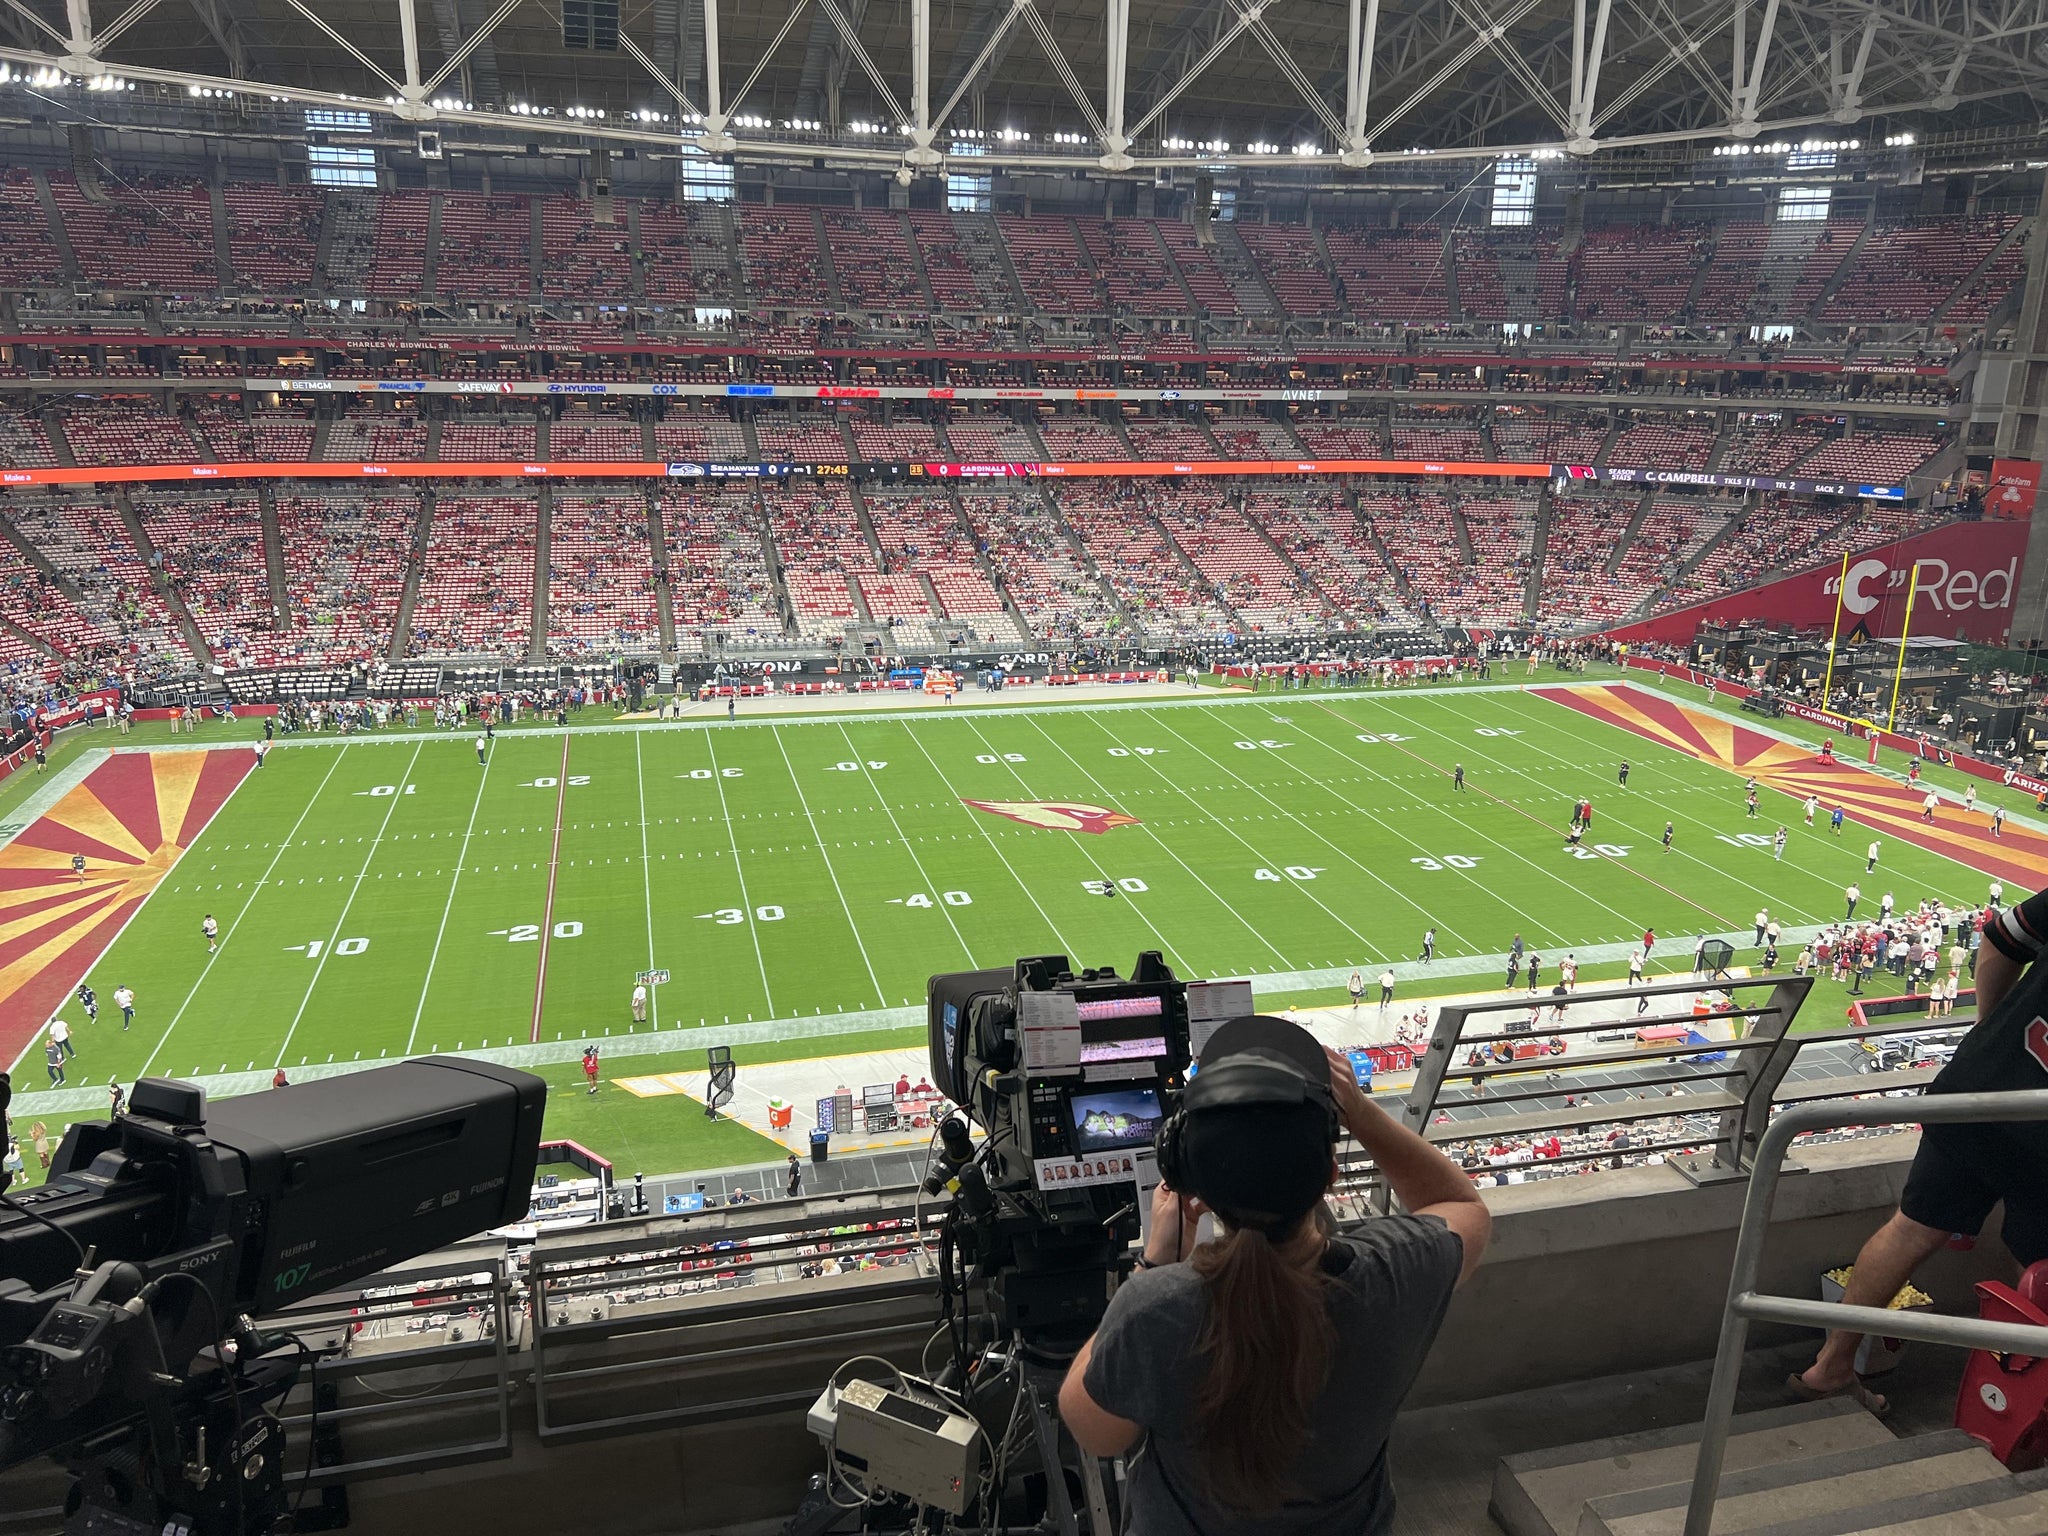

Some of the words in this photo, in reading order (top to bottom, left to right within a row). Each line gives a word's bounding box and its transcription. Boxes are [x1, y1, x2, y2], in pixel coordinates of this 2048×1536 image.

[347, 341, 385, 349] CHARLES
[400, 342, 436, 350] BIDWILL,
[1867, 366, 1916, 374] CONZELMAN
[292, 382, 331, 390] BETMGM
[378, 382, 411, 390] FINANCIAL
[458, 383, 499, 392] SAFEWAY
[652, 385, 678, 394] COX
[1282, 390, 1322, 400] AVNET
[193, 467, 211, 476] Make
[768, 465, 777, 474] 0
[806, 465, 811, 475] 1
[816, 464, 848, 475] 27:45
[939, 465, 947, 474] 0
[1608, 468, 1636, 476] SEASON
[4, 473, 21, 481] Make
[1645, 472, 1656, 481] C.
[1657, 472, 1717, 484] CAMPBELL
[1724, 477, 1742, 485] TKLS
[1789, 482, 1796, 490] 2
[1815, 485, 1834, 493] SACK
[1837, 486, 1844, 494] 2
[1906, 556, 2018, 612] Red
[1800, 709, 1848, 728] CARDINALS
[1355, 732, 1404, 744] 20
[1473, 726, 1516, 738] 10
[1233, 738, 1284, 750] 30
[1107, 746, 1155, 757] 40
[975, 752, 1028, 765] 50
[835, 759, 888, 772] 40
[689, 767, 744, 780] 30
[534, 775, 591, 788] 20
[369, 784, 417, 797] 10
[1715, 832, 1770, 847] 10
[1563, 843, 1618, 860] 20
[1410, 854, 1472, 871] 30
[1253, 865, 1316, 884] 40
[1080, 877, 1149, 895] 50
[905, 890, 973, 909] 40
[713, 905, 785, 926] 30
[507, 921, 584, 943] 20
[305, 937, 370, 959] 10
[641, 976, 667, 985] NFL
[770, 1111, 779, 1122] G
[470, 1176, 505, 1196] FUJINON
[280, 1240, 318, 1259] FUJIFILM
[179, 1250, 221, 1271] SONY
[273, 1262, 312, 1293] 107
[1988, 1393, 1997, 1404] A
